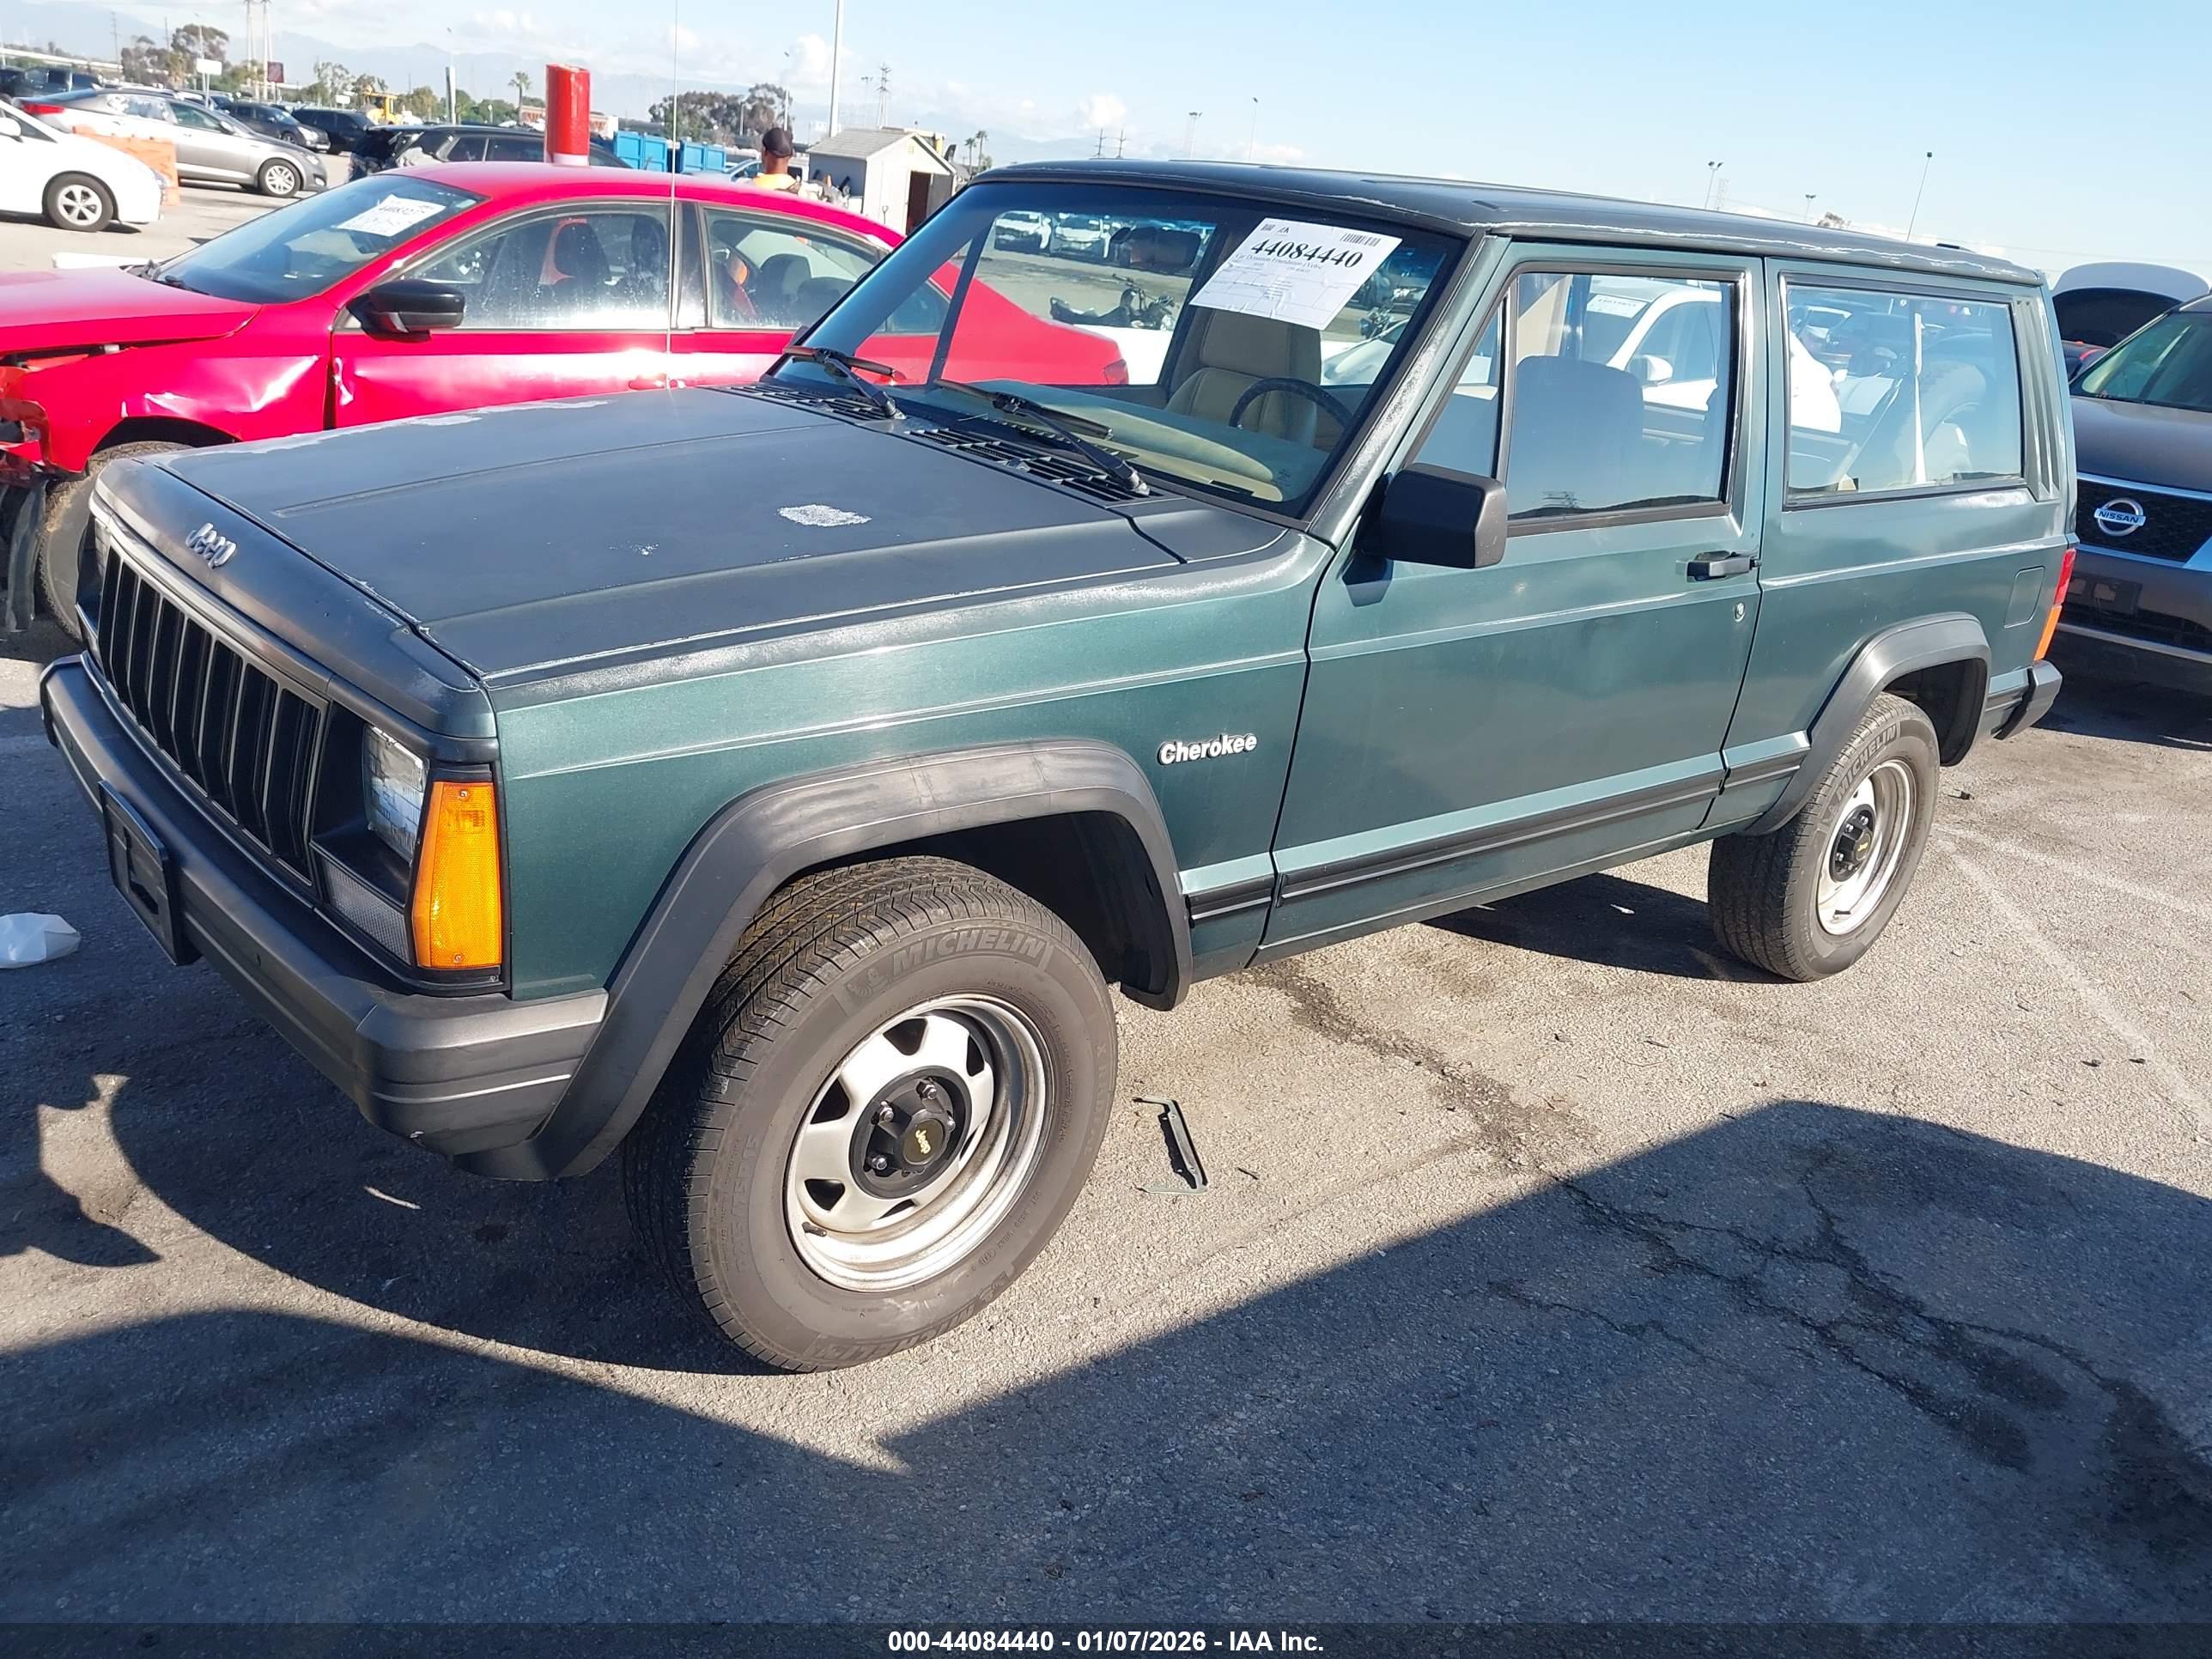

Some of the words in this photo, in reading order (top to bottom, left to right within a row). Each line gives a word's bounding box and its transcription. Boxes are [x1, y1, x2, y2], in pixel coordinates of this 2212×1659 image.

[1250, 239, 1364, 268] 44084440
[2098, 510, 2140, 524] NISSAN
[185, 522, 237, 569] Jeep
[1158, 732, 1258, 765] Cherokee
[1835, 723, 1897, 802] MICHELIN
[894, 928, 1045, 976] MICHELIN
[915, 1128, 933, 1155] Jeep
